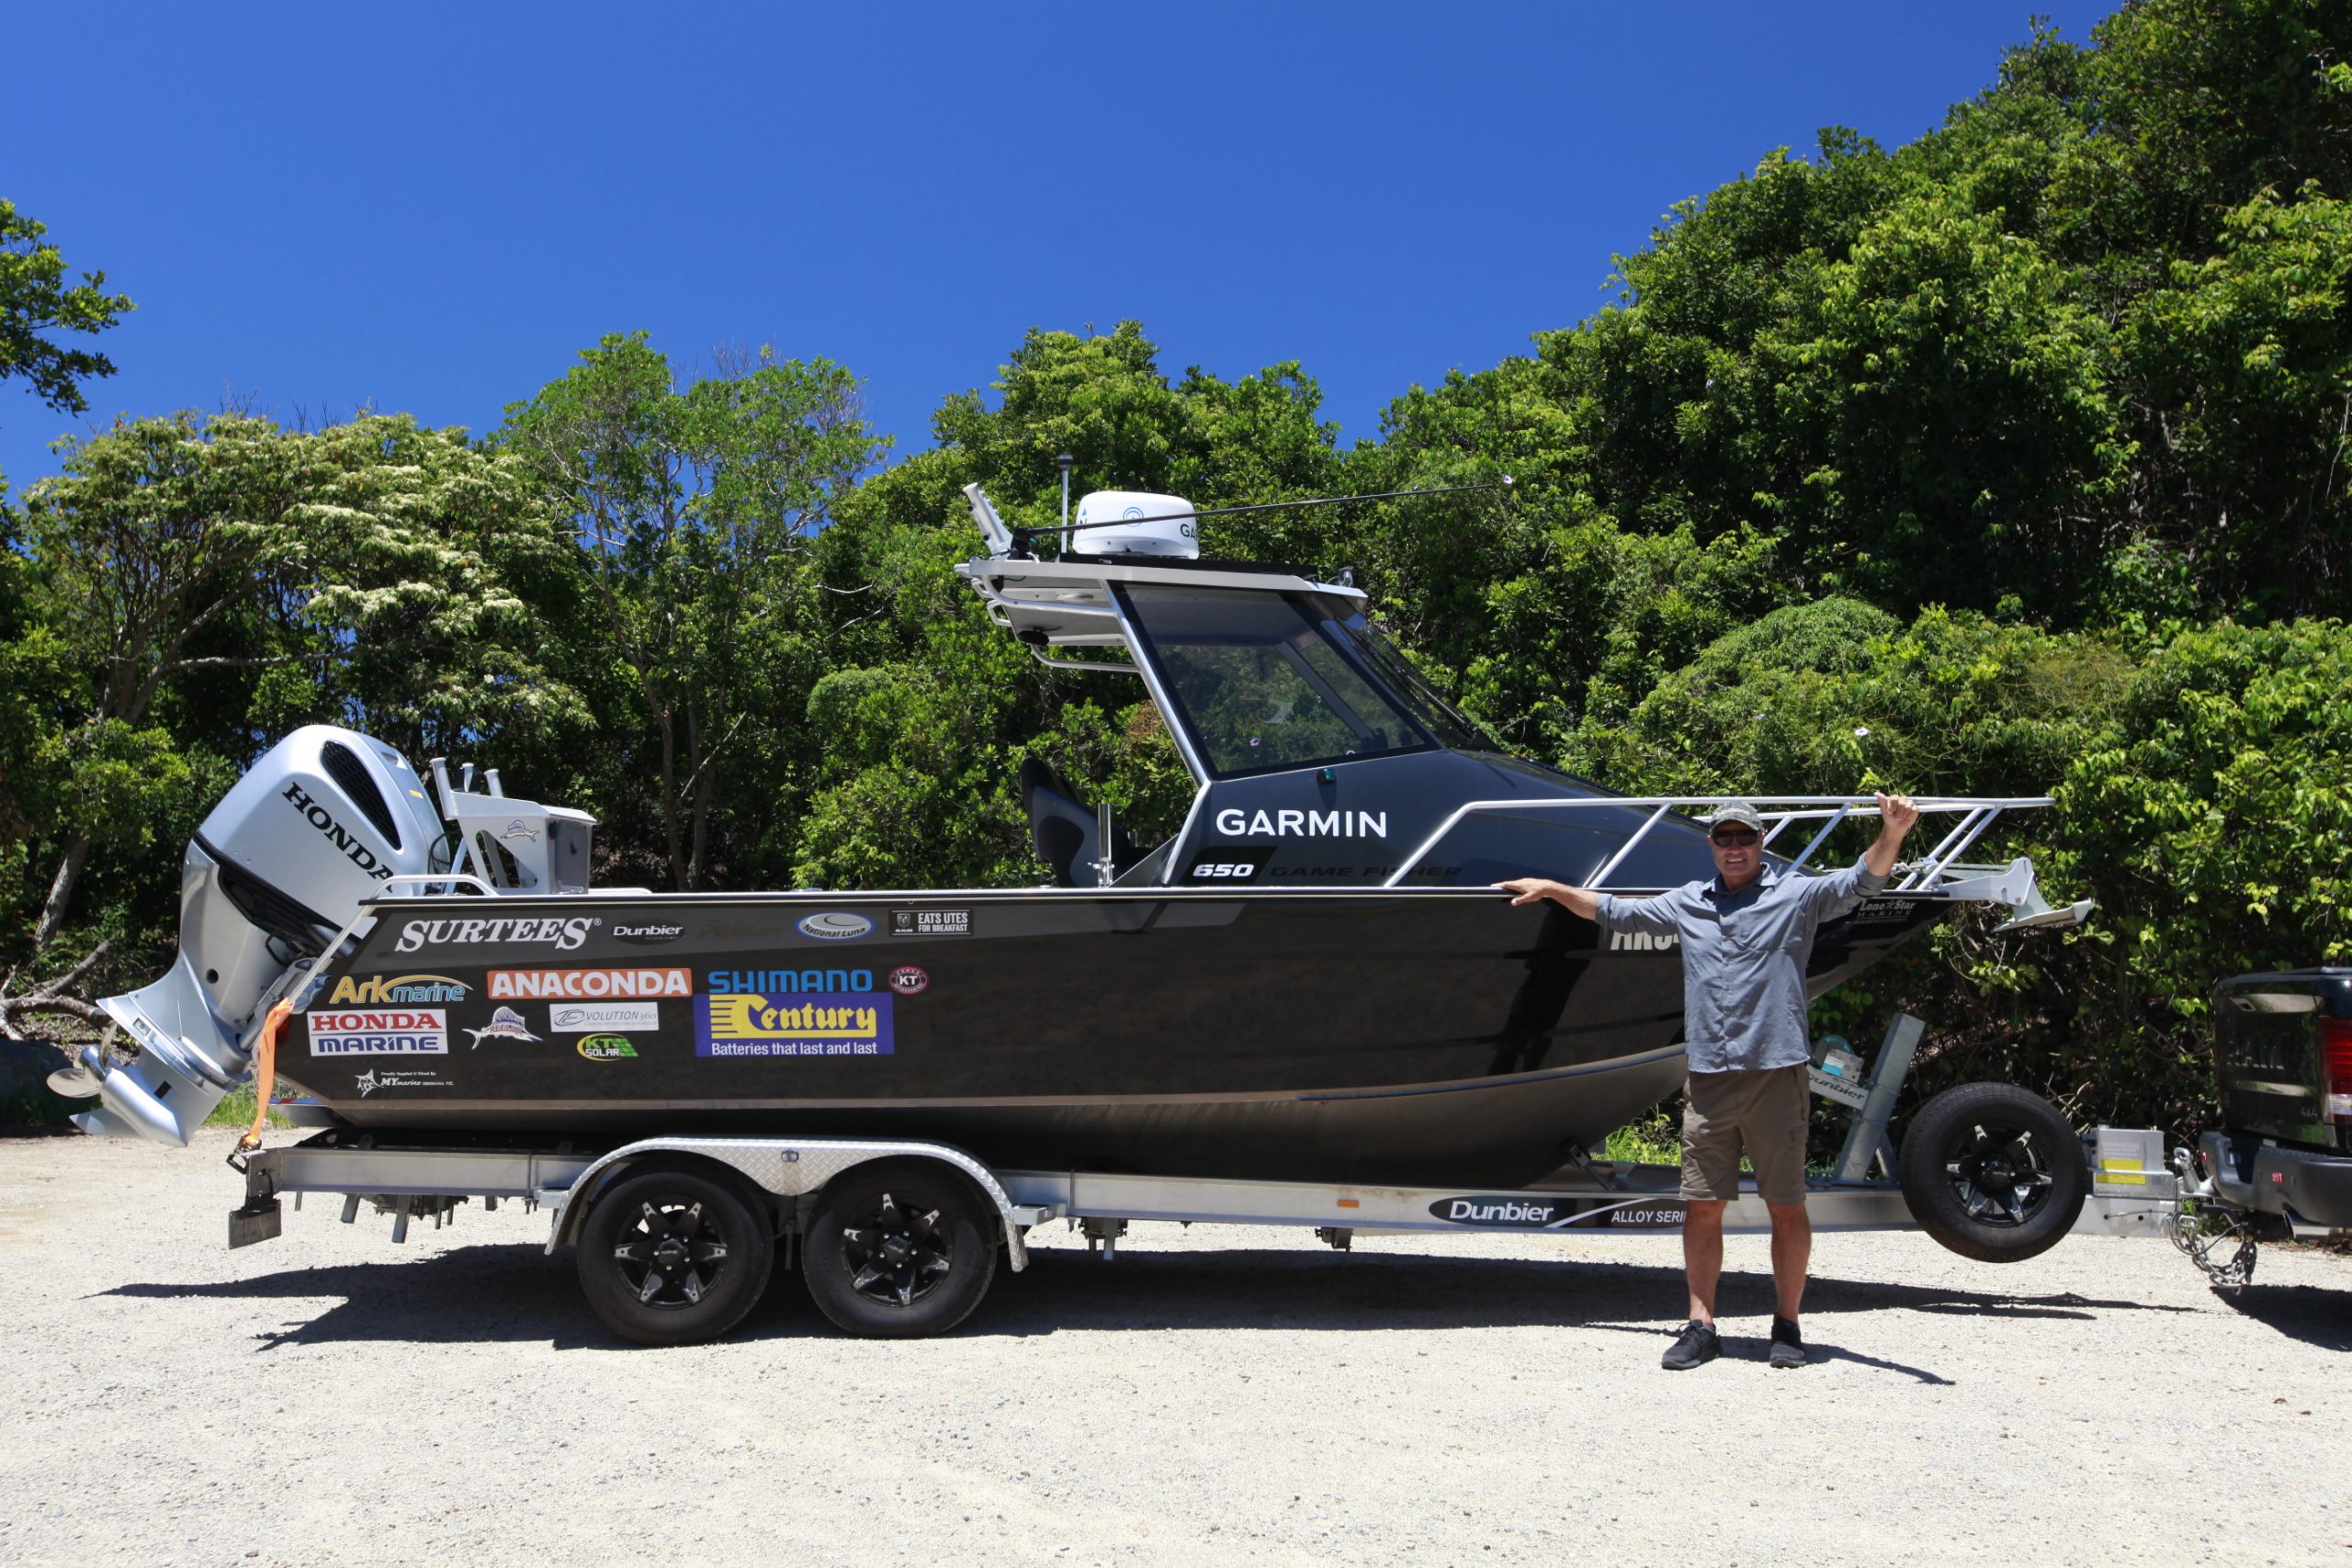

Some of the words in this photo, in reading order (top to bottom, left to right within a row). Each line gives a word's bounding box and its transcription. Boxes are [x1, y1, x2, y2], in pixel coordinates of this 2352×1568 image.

[1216, 808, 1386, 838] GARMIN
[282, 782, 393, 893] HONDA
[1193, 863, 1254, 877] 650
[1269, 866, 1351, 877] GAME
[1860, 899, 1886, 911] Lone
[1894, 898, 1917, 910] Star
[919, 912, 943, 924] EATS
[944, 912, 968, 924] UTES
[395, 917, 594, 953] SURTEES
[613, 925, 684, 936] Dunbier
[803, 923, 843, 938] National
[842, 927, 865, 938] Luna
[919, 924, 931, 932] FOR
[932, 924, 968, 932] BREAKFAST
[492, 970, 689, 997] ANACONDA
[707, 969, 873, 993] SHIMANO
[899, 976, 917, 986] KT
[311, 1013, 442, 1032] HONDA
[639, 1012, 657, 1021] 360
[709, 994, 877, 1039] Century
[585, 1037, 614, 1048] KT
[711, 1043, 770, 1055] Batteries
[772, 1043, 797, 1055] that
[799, 1043, 823, 1055] last
[827, 1043, 851, 1055] and
[854, 1042, 877, 1055] last
[585, 1048, 620, 1056] SOLAR
[1449, 1201, 1554, 1222] Dunbier
[1611, 1210, 1655, 1224] ALLOY
